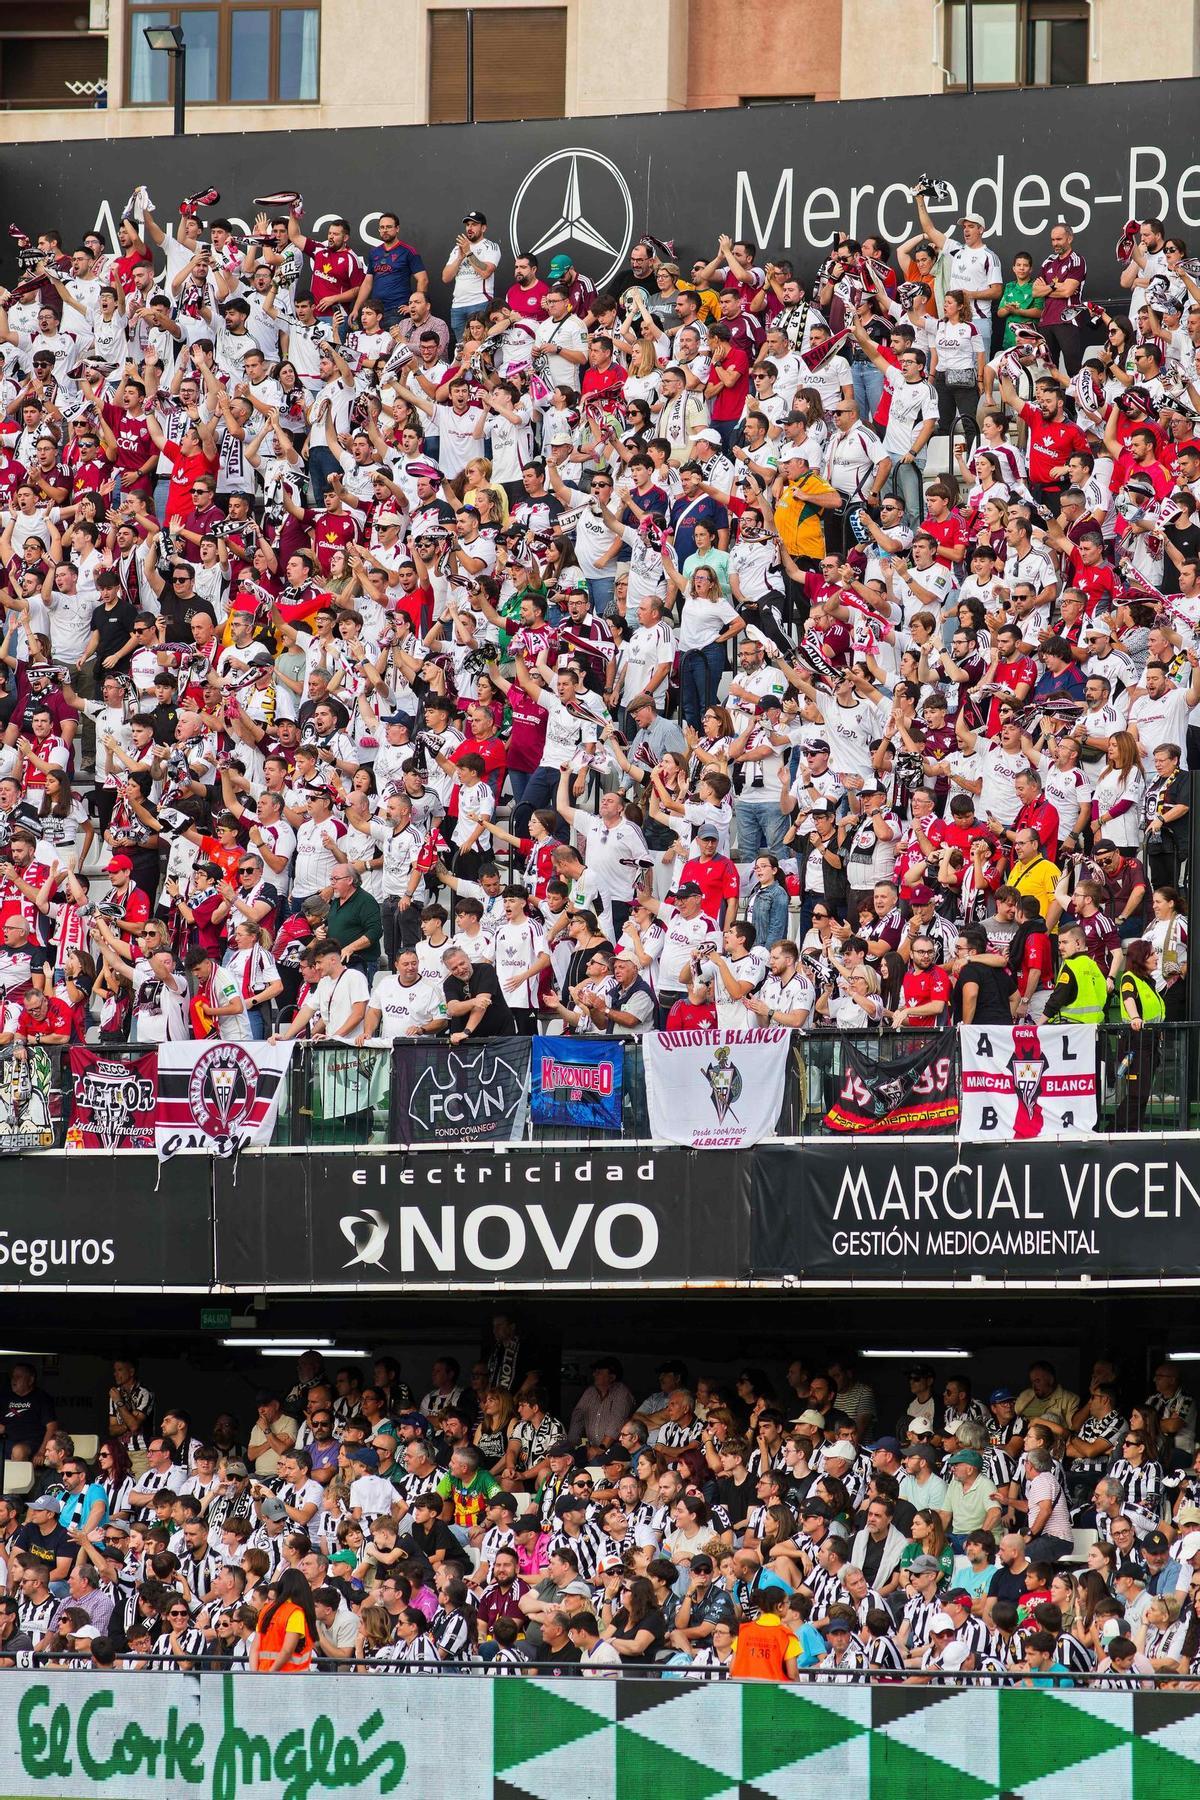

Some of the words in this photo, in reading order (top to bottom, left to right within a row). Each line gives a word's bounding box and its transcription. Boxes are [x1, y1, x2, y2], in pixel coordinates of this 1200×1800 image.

[115, 437, 138, 452] CCM
[385, 1003, 410, 1016] iner
[657, 1028, 722, 1051] QUIJOTE
[725, 1026, 787, 1046] BLANCO
[1015, 1029, 1034, 1038] PEÑA
[976, 1033, 994, 1058] A
[1062, 1035, 1077, 1060] L
[966, 1076, 1011, 1090] MANCHA
[1046, 1079, 1094, 1092] BLANCA
[429, 1086, 505, 1124] FCVN
[435, 1128, 459, 1137] FONDO
[459, 1121, 498, 1135] COVANEGR
[979, 1106, 998, 1131] B
[691, 1137, 742, 1147] ALBACETE
[351, 1159, 656, 1186] electricidad
[832, 1162, 1044, 1221] MARCIAL
[1059, 1160, 1200, 1220] VICEN
[400, 1201, 660, 1274] NOVO
[832, 1225, 920, 1256] GESTIÓN
[926, 1229, 1100, 1256] MEDIOAMBIENTAL
[0, 1231, 116, 1277] Seguros
[9, 1401, 31, 1409] Reebok
[18, 1683, 72, 1780] El
[76, 1688, 205, 1784] Corte
[211, 1673, 407, 1800] Inglés
